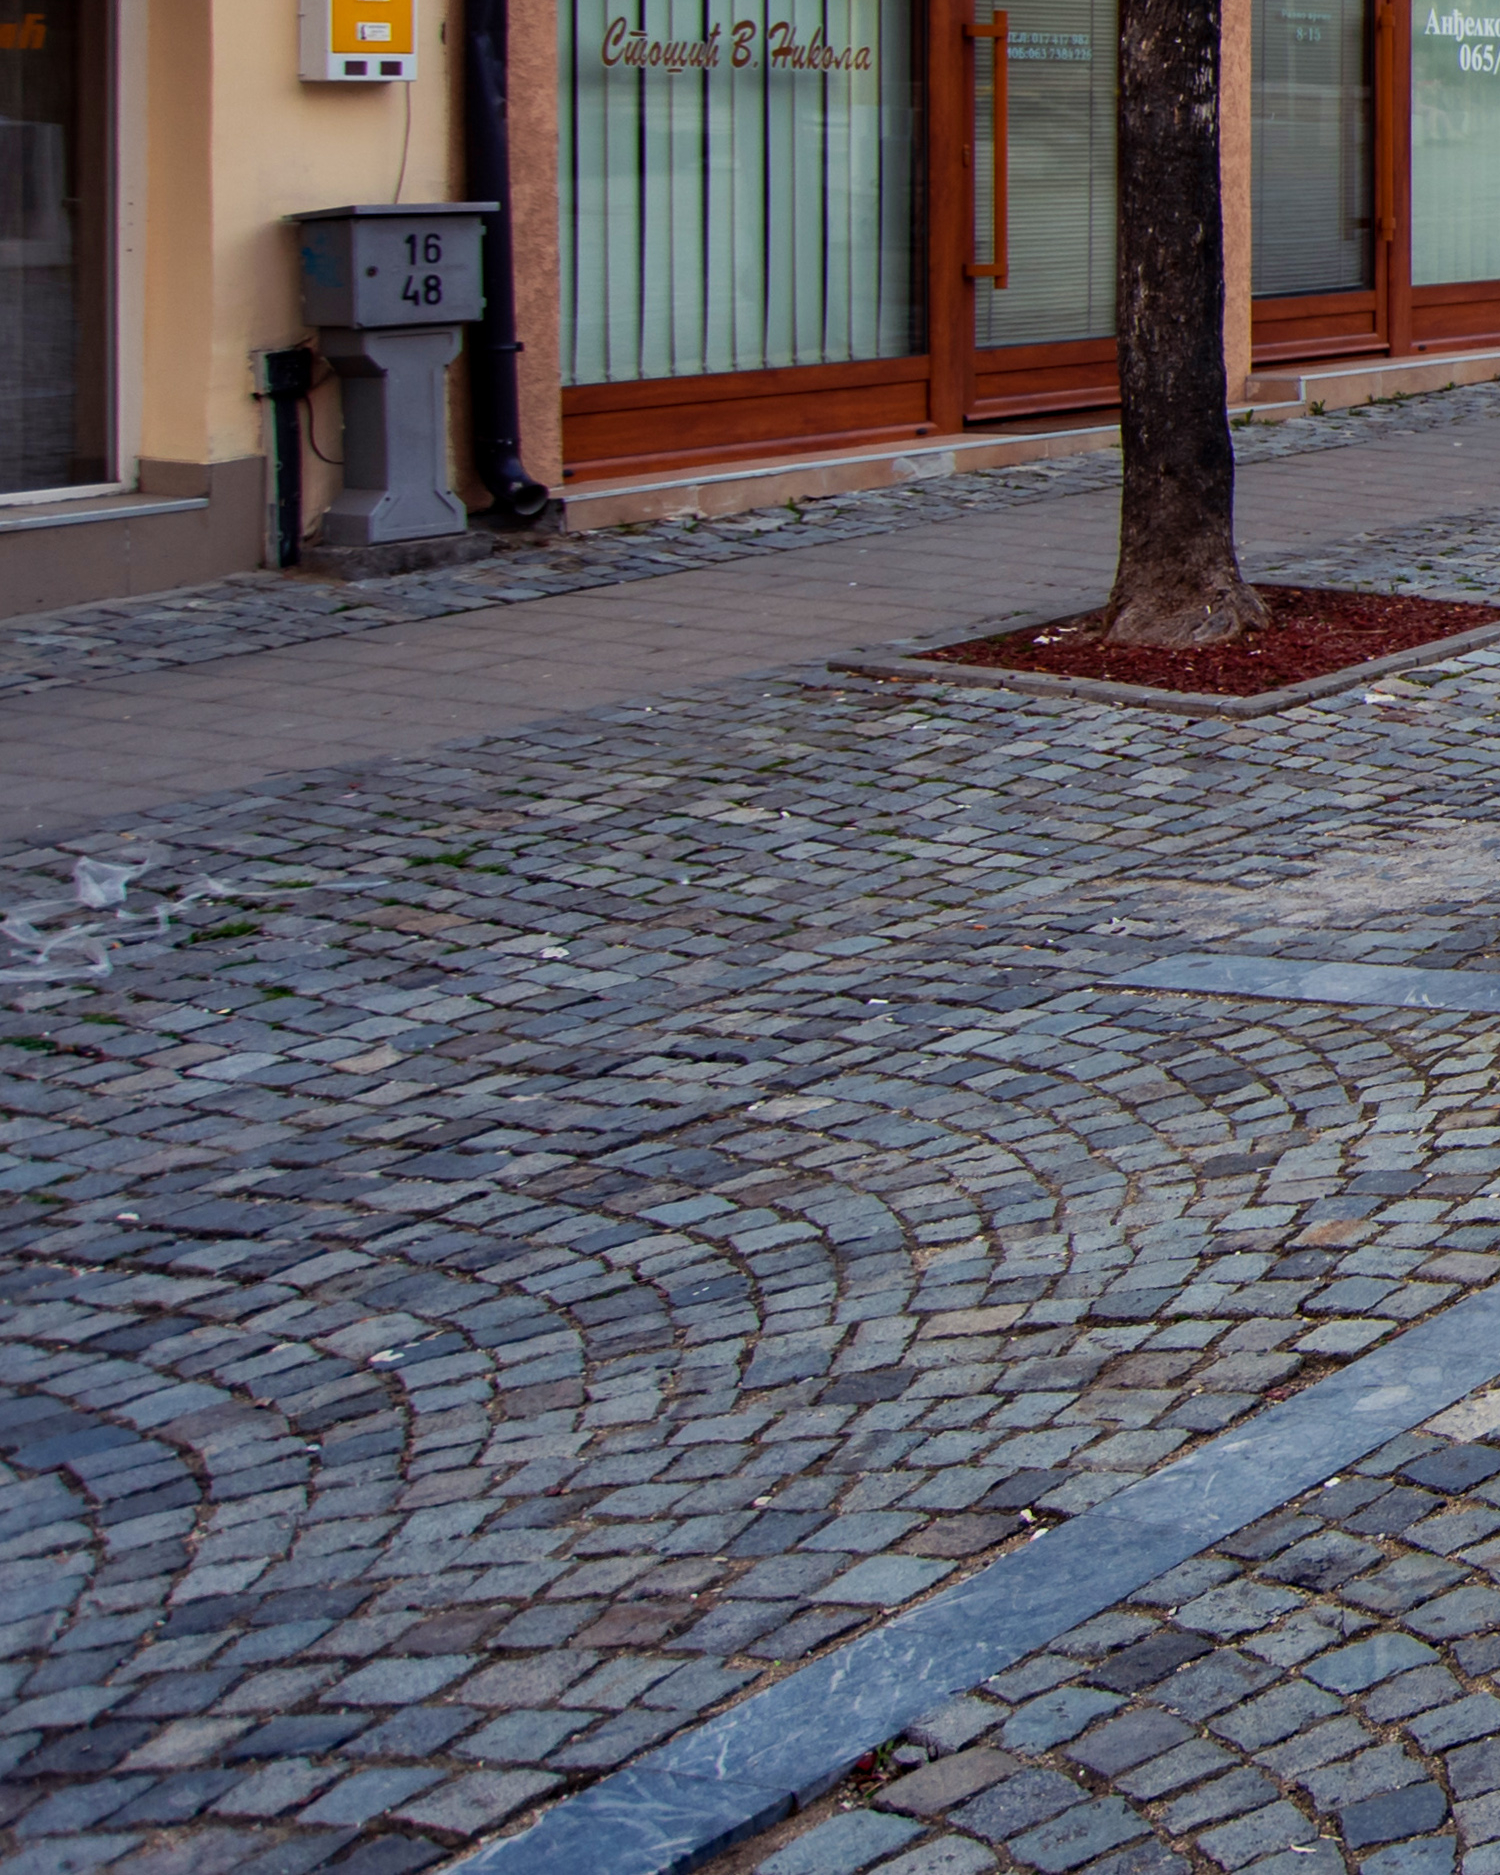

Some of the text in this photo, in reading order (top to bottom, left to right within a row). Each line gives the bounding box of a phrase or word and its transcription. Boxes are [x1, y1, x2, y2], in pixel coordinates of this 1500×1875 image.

[730, 19, 760, 70] В.
[767, 19, 873, 72] Никола
[404, 233, 443, 265] 16
[402, 274, 443, 306] 48
